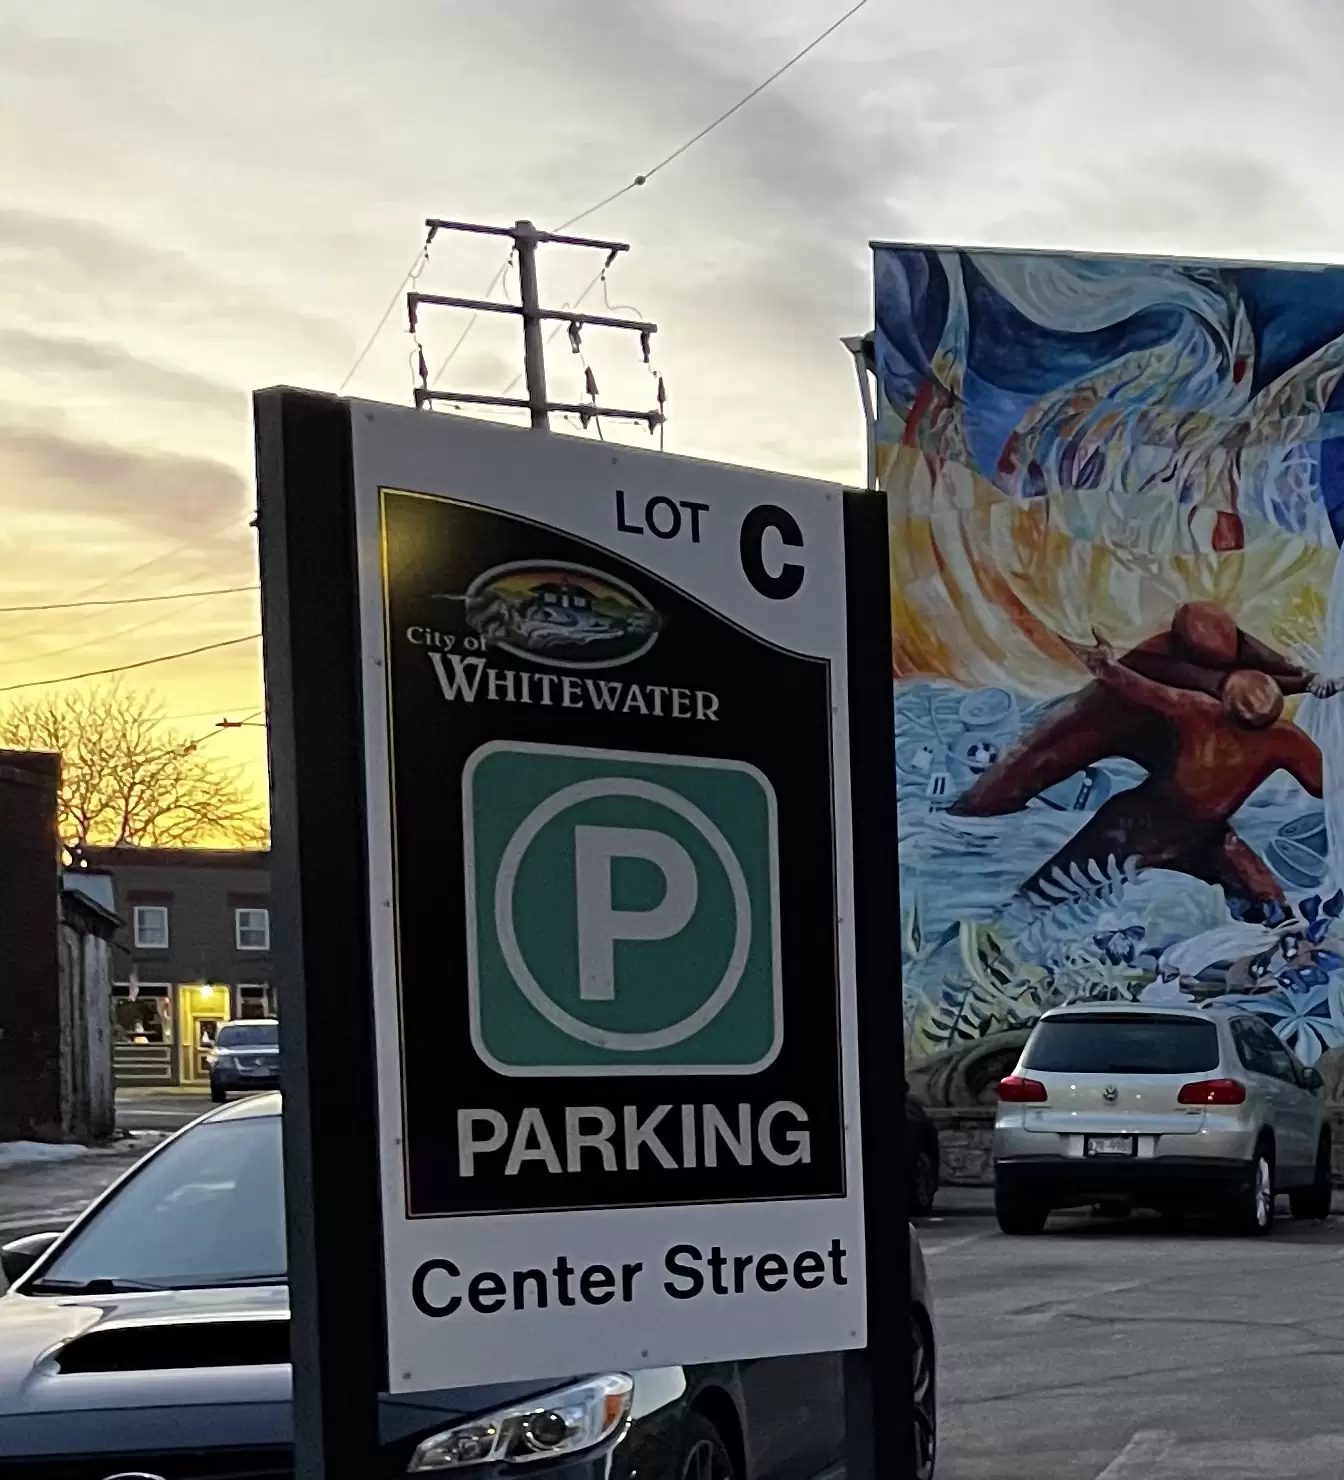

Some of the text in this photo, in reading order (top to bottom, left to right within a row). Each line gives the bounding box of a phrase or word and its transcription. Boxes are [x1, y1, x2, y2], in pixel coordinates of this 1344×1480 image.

[616, 490, 804, 600] LOT C
[406, 625, 456, 652] City
[428, 651, 720, 721] WHITEWATER
[575, 825, 698, 1000] P
[457, 1100, 812, 1177] PARKING
[412, 1238, 848, 1318] Center Street
